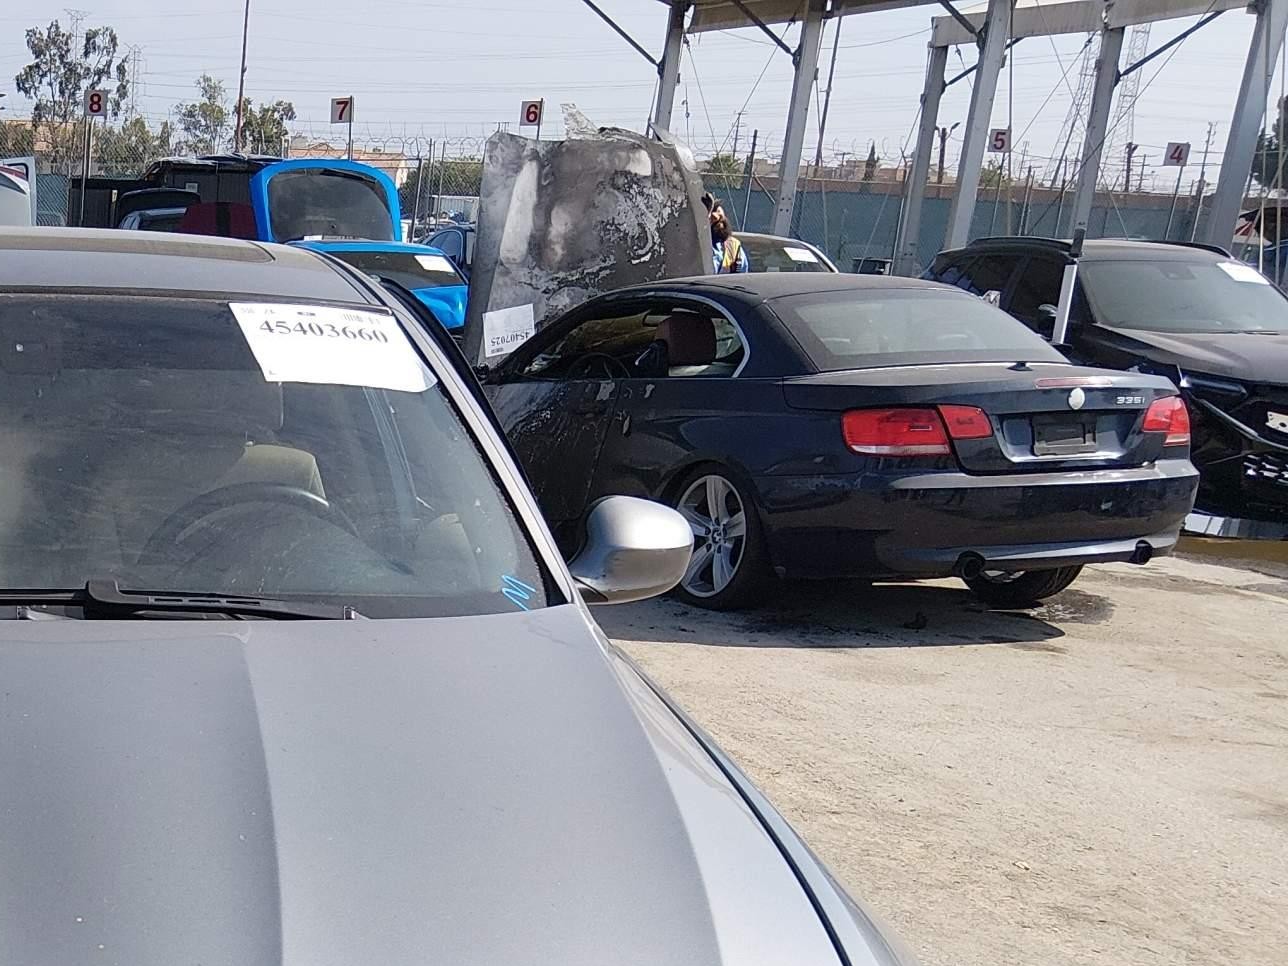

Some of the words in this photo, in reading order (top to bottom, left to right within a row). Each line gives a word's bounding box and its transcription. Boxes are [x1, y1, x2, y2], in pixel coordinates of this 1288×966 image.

[88, 92, 102, 113] 8
[335, 100, 350, 120] 7
[525, 103, 539, 123] 6
[993, 131, 1007, 150] 5
[1169, 145, 1184, 163] 4
[259, 320, 389, 343] 45403660
[1116, 396, 1146, 405] 335i
